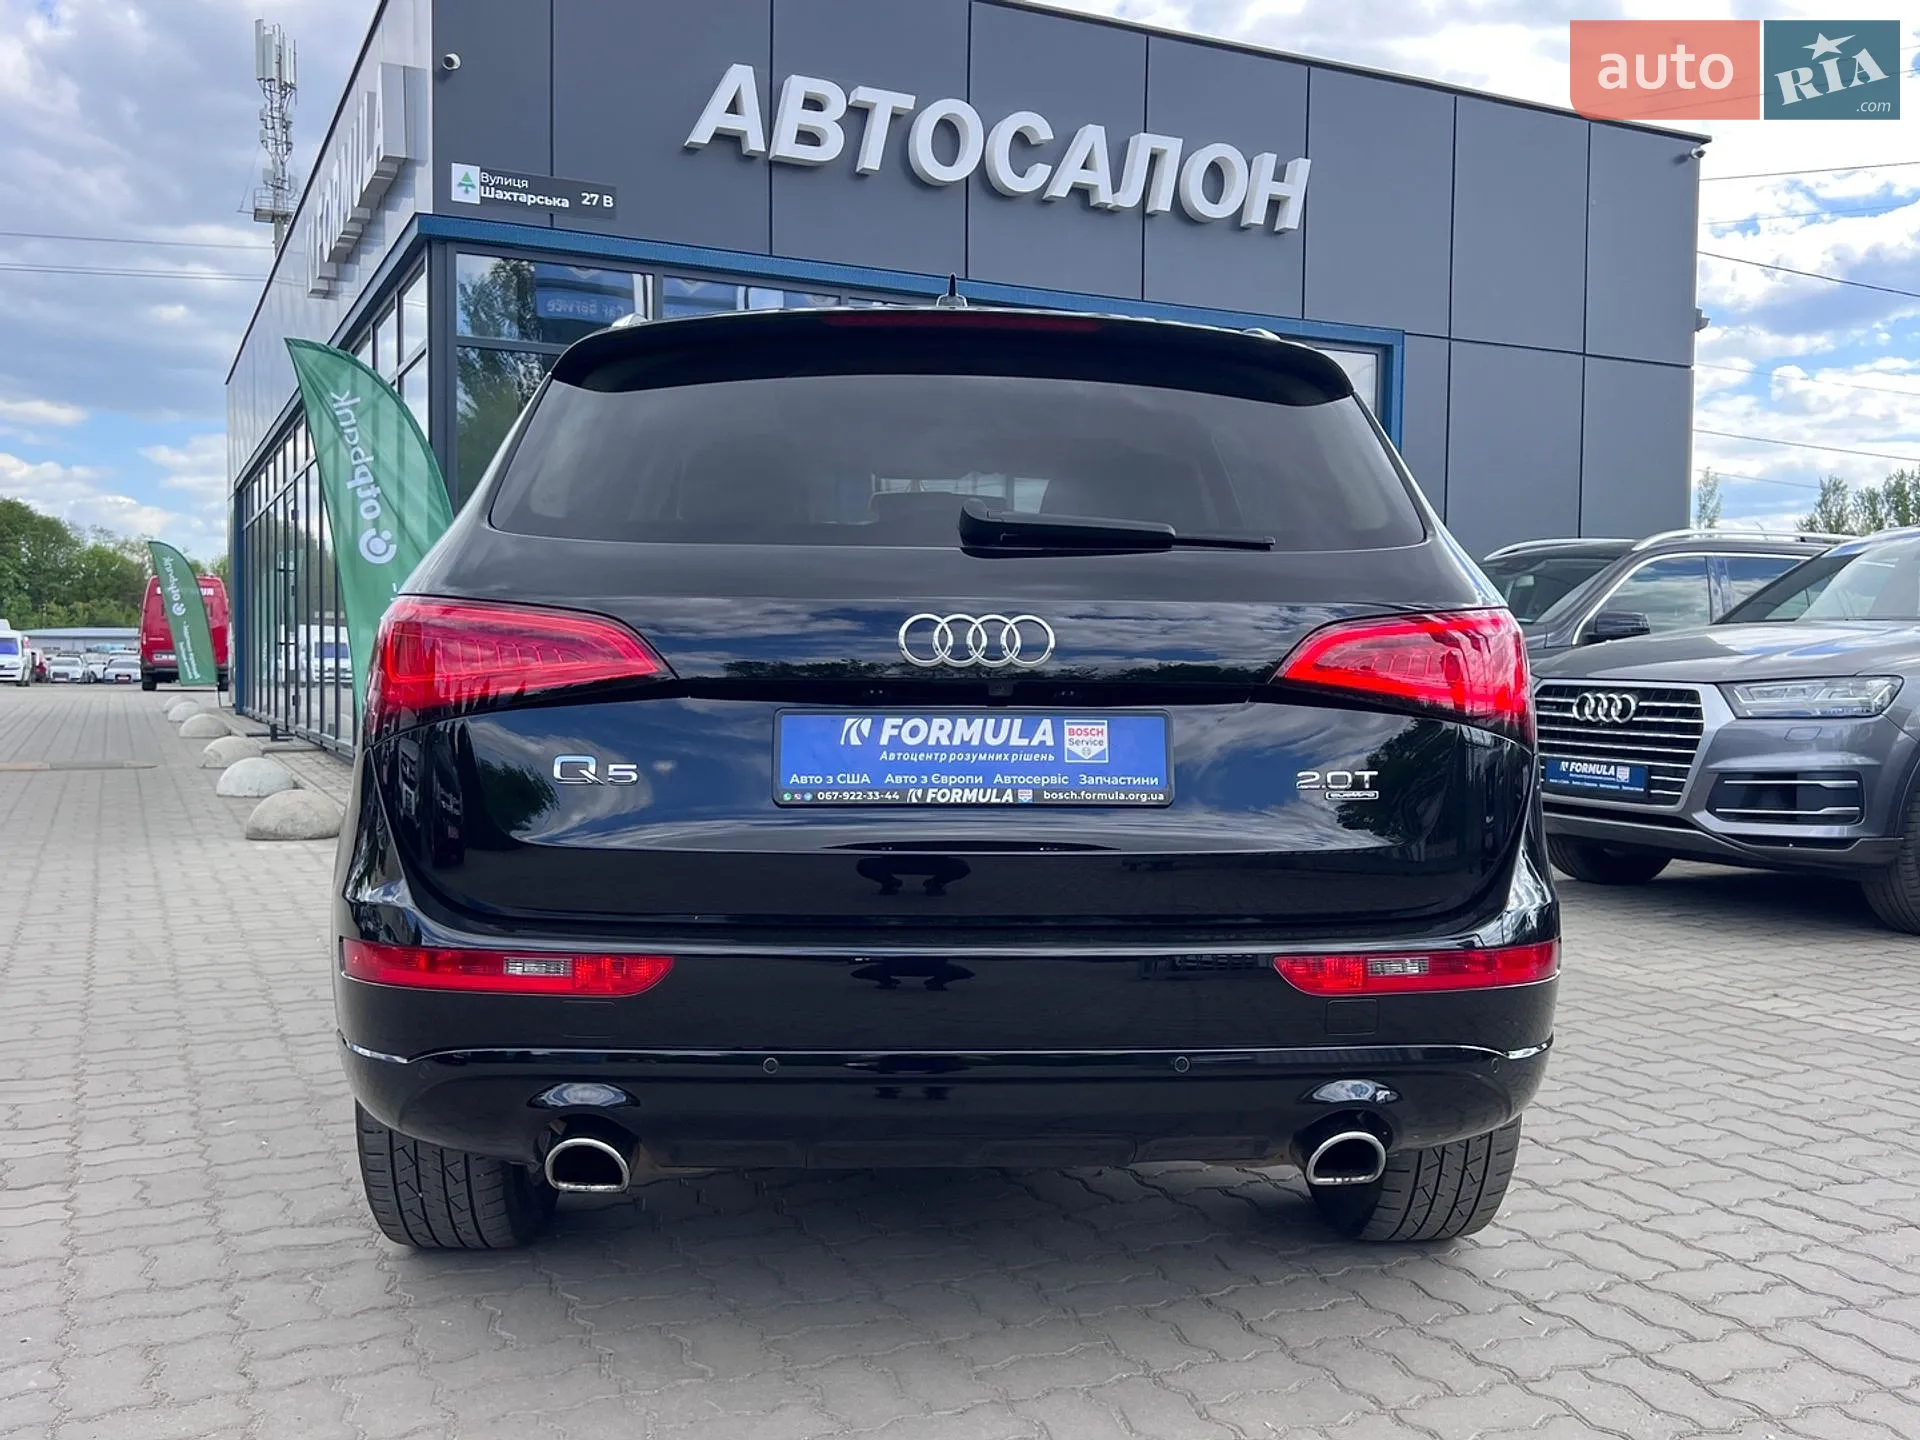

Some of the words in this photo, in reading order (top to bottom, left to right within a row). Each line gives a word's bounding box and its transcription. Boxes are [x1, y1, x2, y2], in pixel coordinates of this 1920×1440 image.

[684, 64, 1311, 233] АВТОСАЛОН
[481, 172, 529, 189] Вулиця
[481, 185, 570, 208] Шахтарська
[580, 192, 600, 207] 27
[602, 194, 614, 208] В
[879, 718, 1055, 746] FORMULA
[1067, 727, 1104, 737] BOSCH
[1067, 738, 1104, 747] Service
[879, 751, 947, 763] Автоцентр
[949, 752, 1010, 763] розумних
[1010, 751, 1055, 763] рішень
[553, 755, 638, 786] Q5
[1569, 761, 1615, 776] FORMULA
[789, 773, 823, 785] Авто
[826, 775, 834, 785] з
[837, 773, 871, 785] США
[884, 773, 918, 785] Авто
[920, 775, 928, 785] з
[931, 773, 983, 787] Європи
[993, 773, 1069, 787] Автосервіс
[1079, 774, 1159, 786] Запчастини
[1296, 770, 1379, 790] 2.0T
[926, 788, 1014, 803] FORMULA
[1043, 790, 1165, 802] bosch.formula.org.ua
